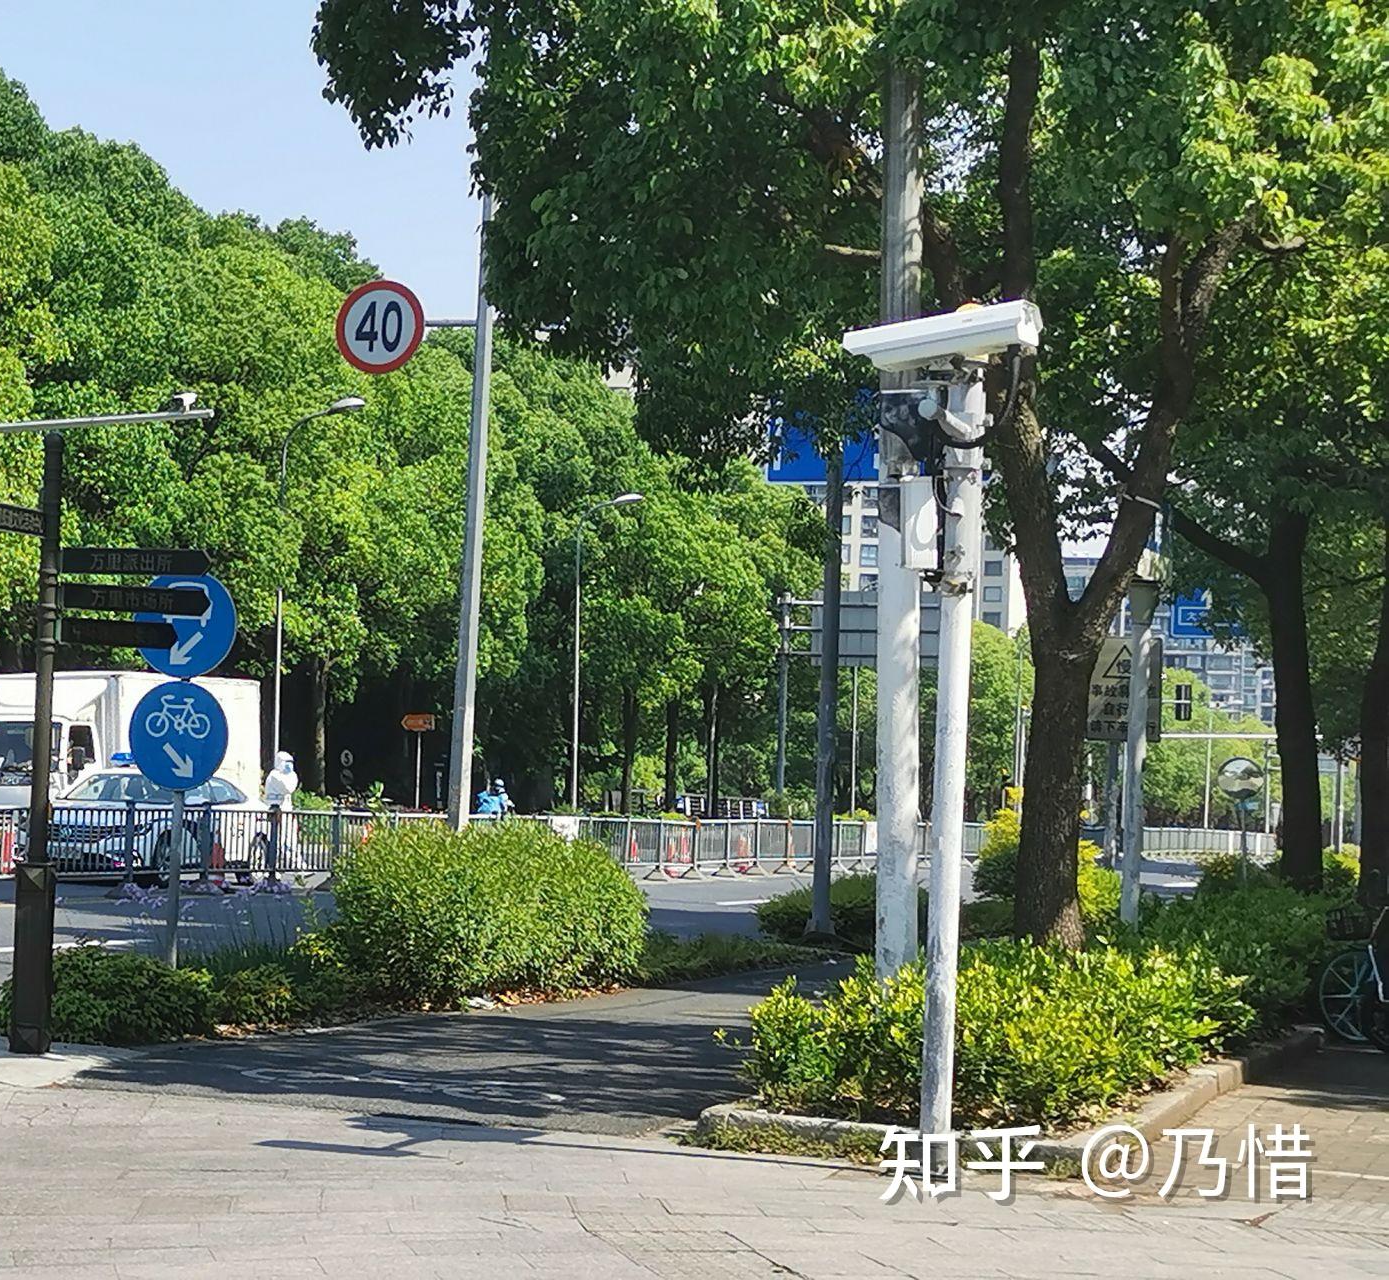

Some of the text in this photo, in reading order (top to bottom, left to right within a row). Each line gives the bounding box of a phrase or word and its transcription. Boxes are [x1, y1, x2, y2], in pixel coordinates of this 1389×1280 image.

[354, 300, 403, 353] 40
[90, 553, 173, 573] 万里派出所
